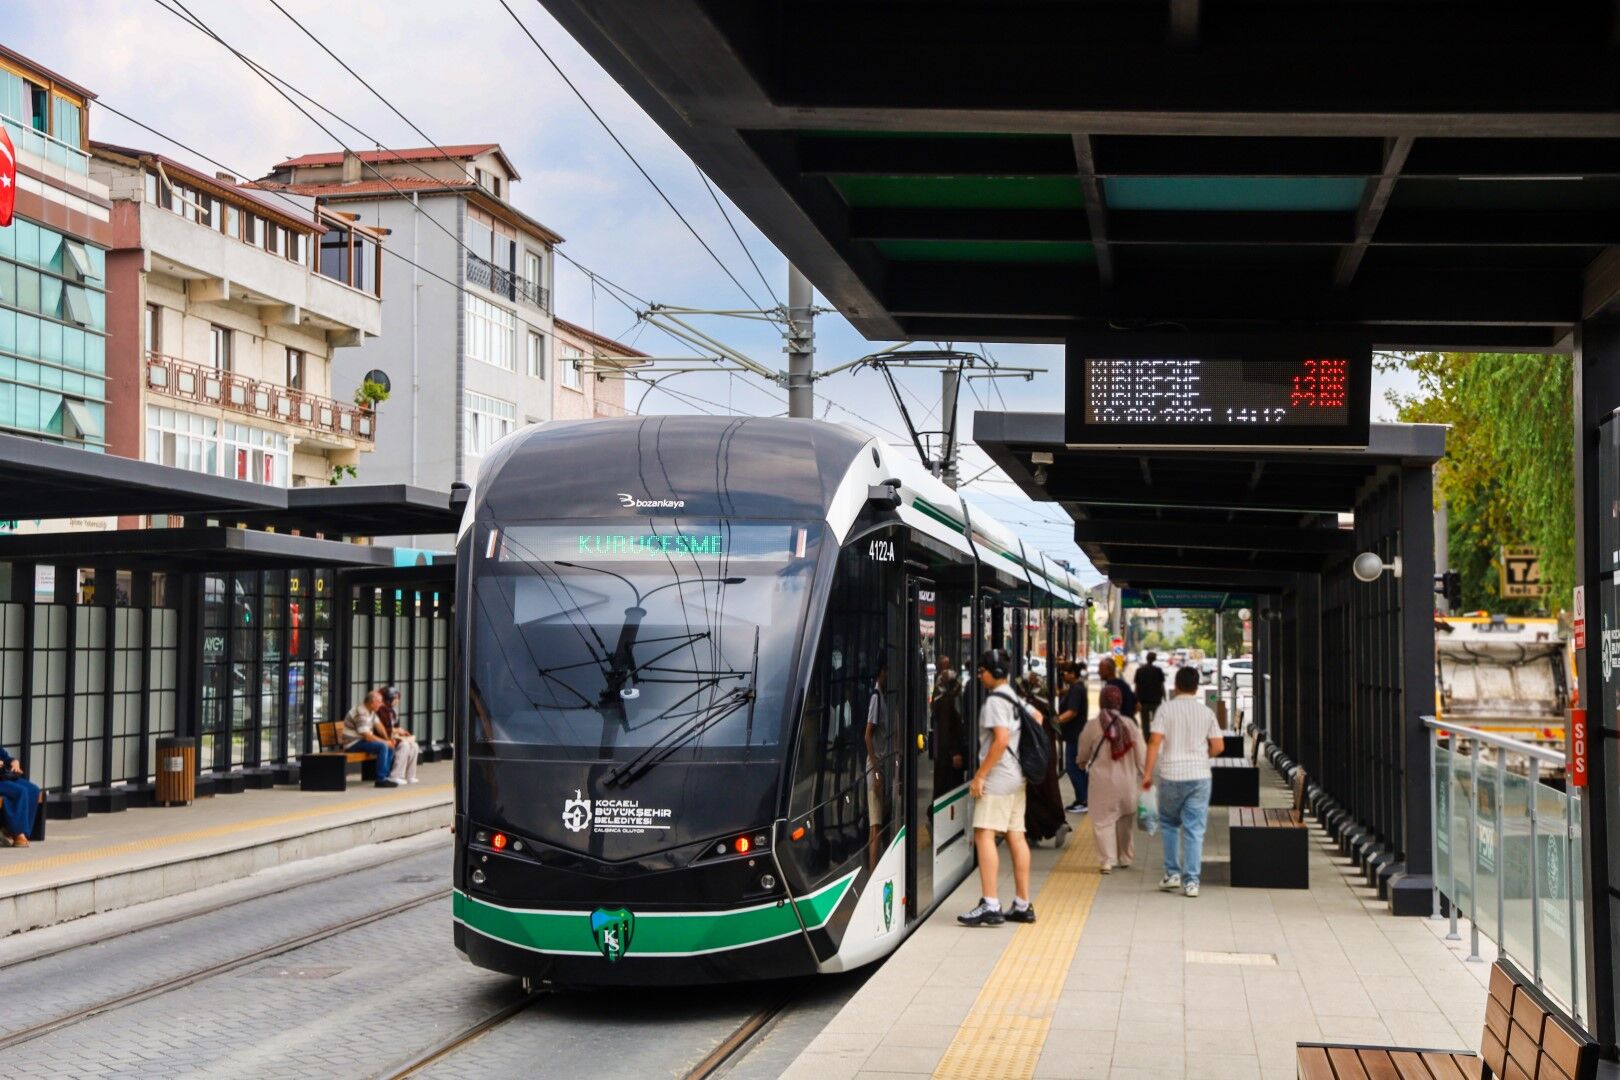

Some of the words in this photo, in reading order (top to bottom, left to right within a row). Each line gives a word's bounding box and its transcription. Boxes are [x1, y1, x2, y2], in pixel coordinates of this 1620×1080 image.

[635, 498, 685, 509] bozankaya
[578, 535, 723, 557] KURUÇEŞME
[868, 540, 895, 562] 4122-A
[1574, 722, 1585, 773] SOS
[594, 807, 672, 818] BÜYÜKŞEHİR
